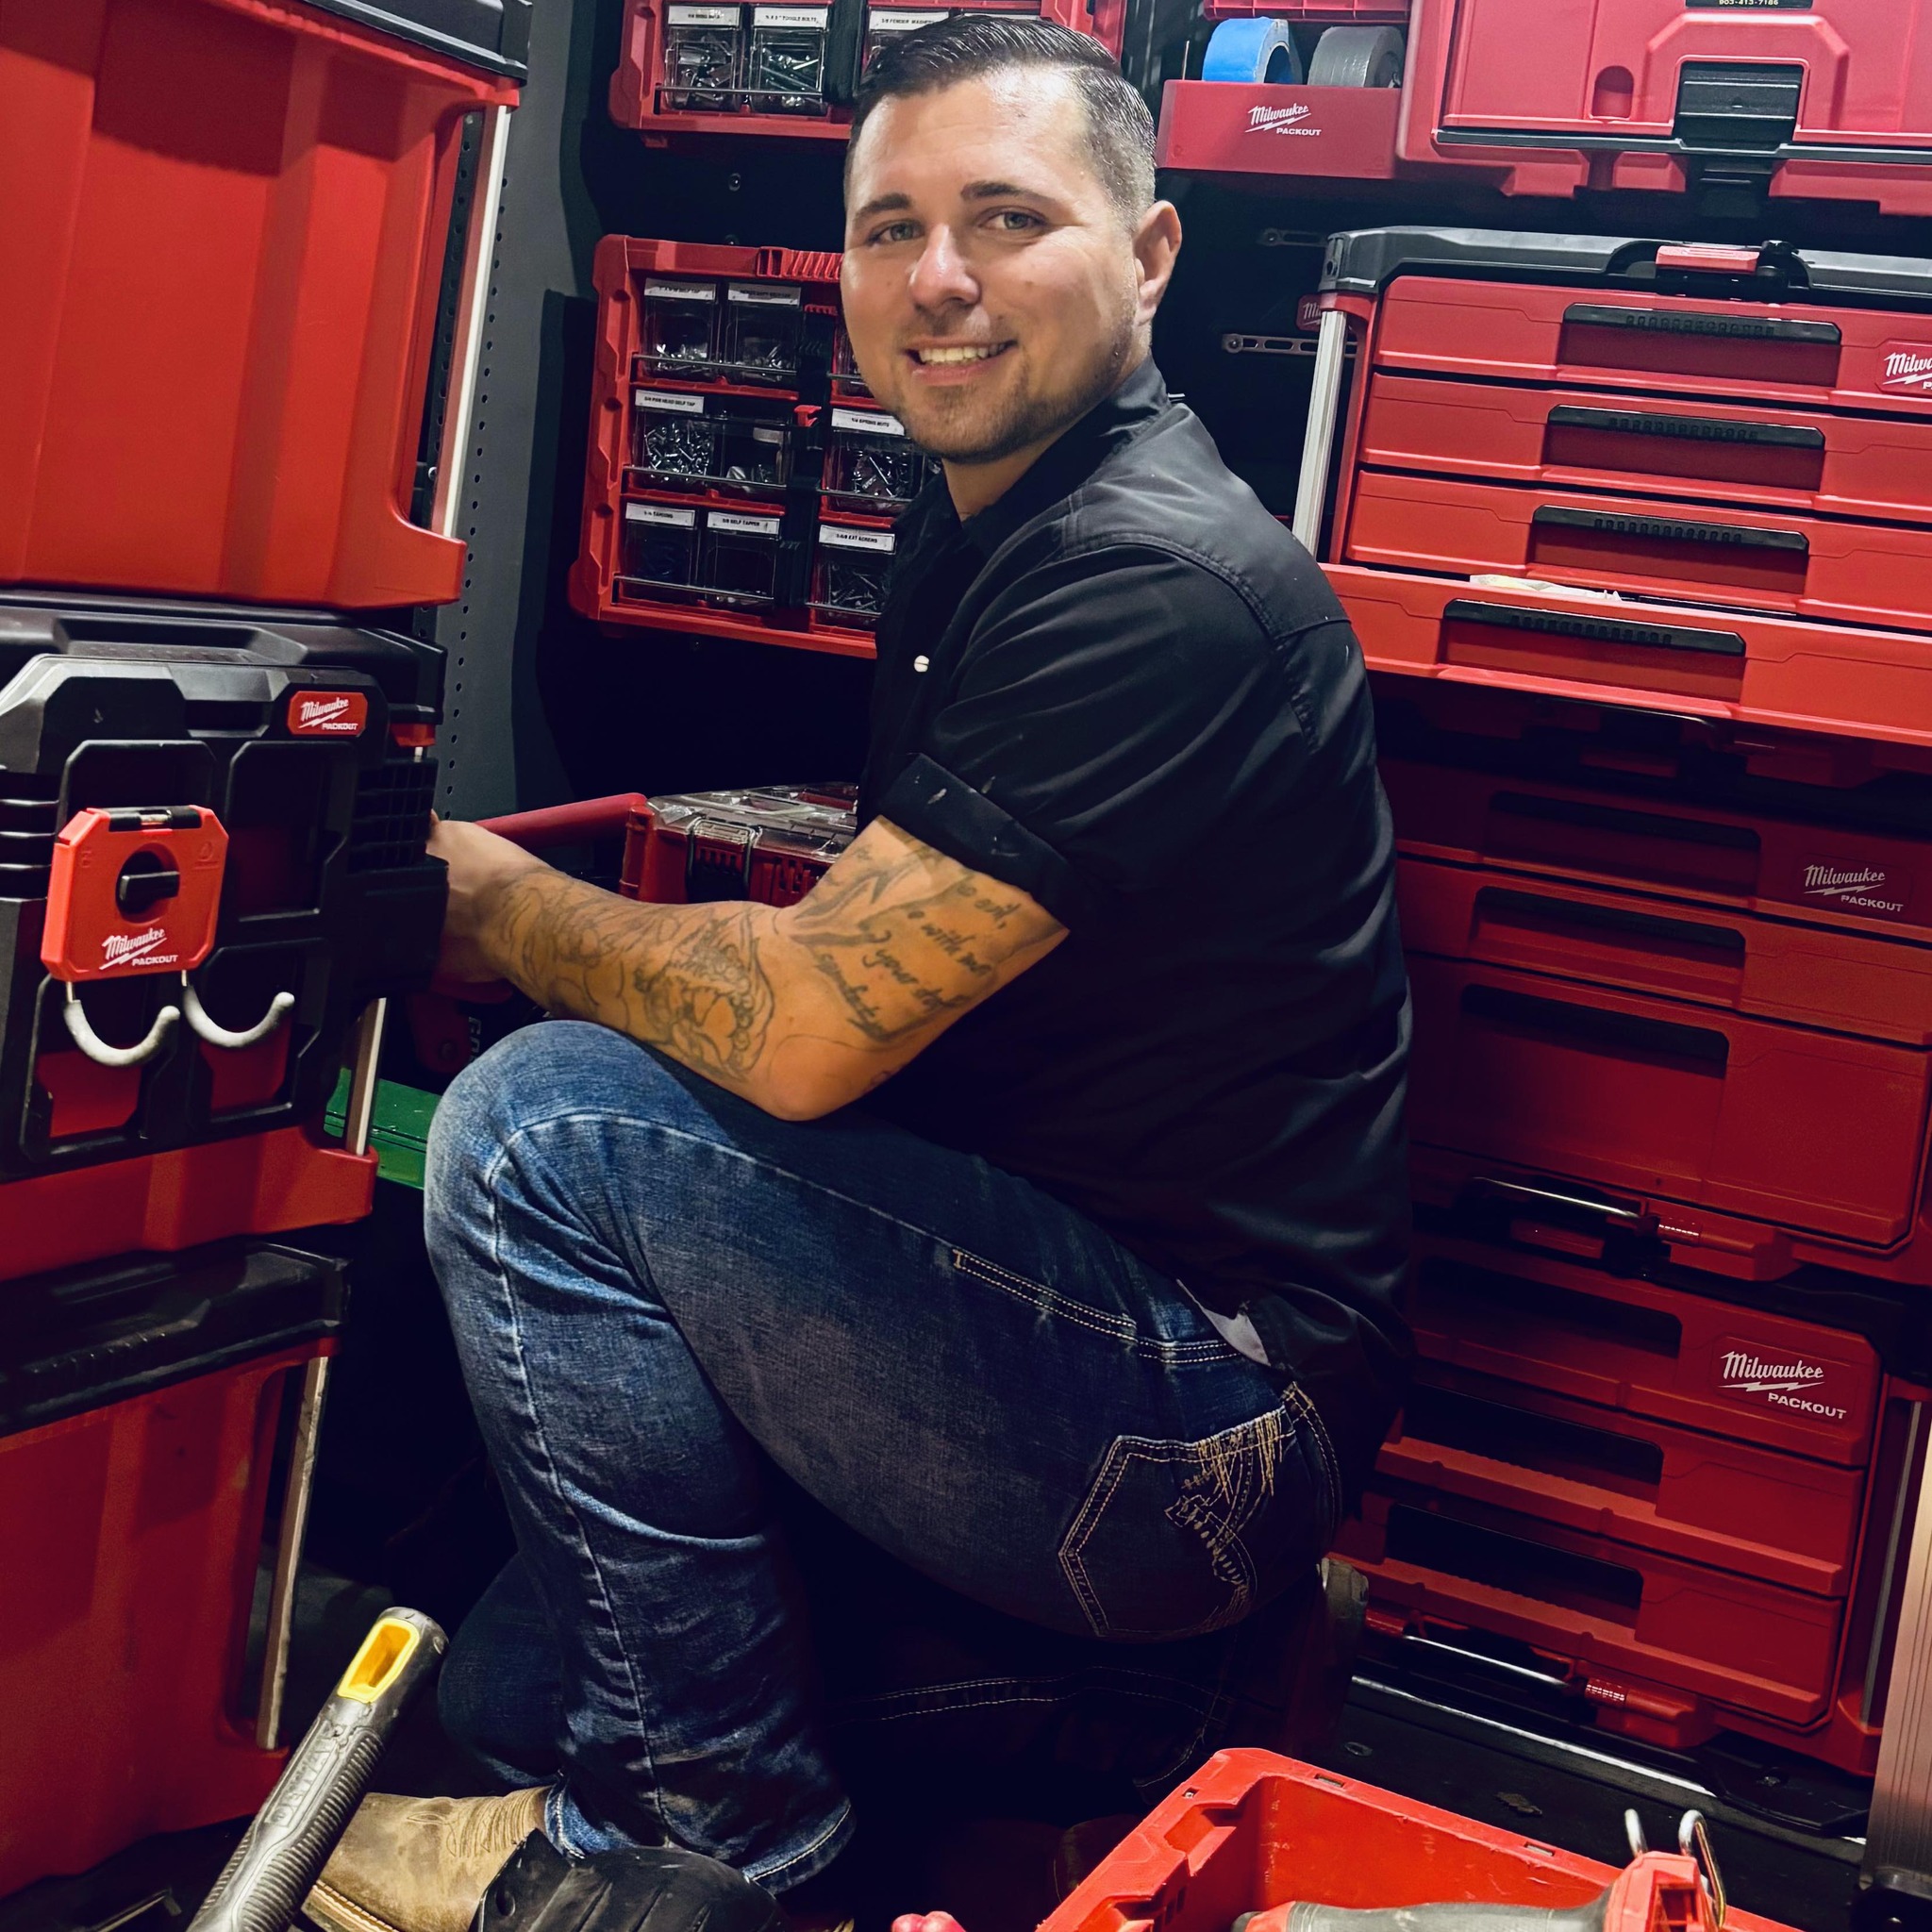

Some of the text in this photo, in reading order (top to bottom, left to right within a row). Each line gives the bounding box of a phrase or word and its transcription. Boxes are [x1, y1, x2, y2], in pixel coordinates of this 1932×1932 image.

[1247, 103, 1309, 125] Milwaukee
[1276, 127, 1322, 136] PACKOUT
[301, 696, 349, 722] Milwaukee
[322, 723, 358, 731] PACKOUT
[1804, 864, 1886, 888] Milwaukee
[1840, 894, 1905, 912] PACKOUT
[101, 927, 166, 960] Milwaukee
[132, 954, 179, 967] PACKOUT
[1720, 1351, 1824, 1379] Milwaukee
[1768, 1392, 1847, 1419] PACKOUT
